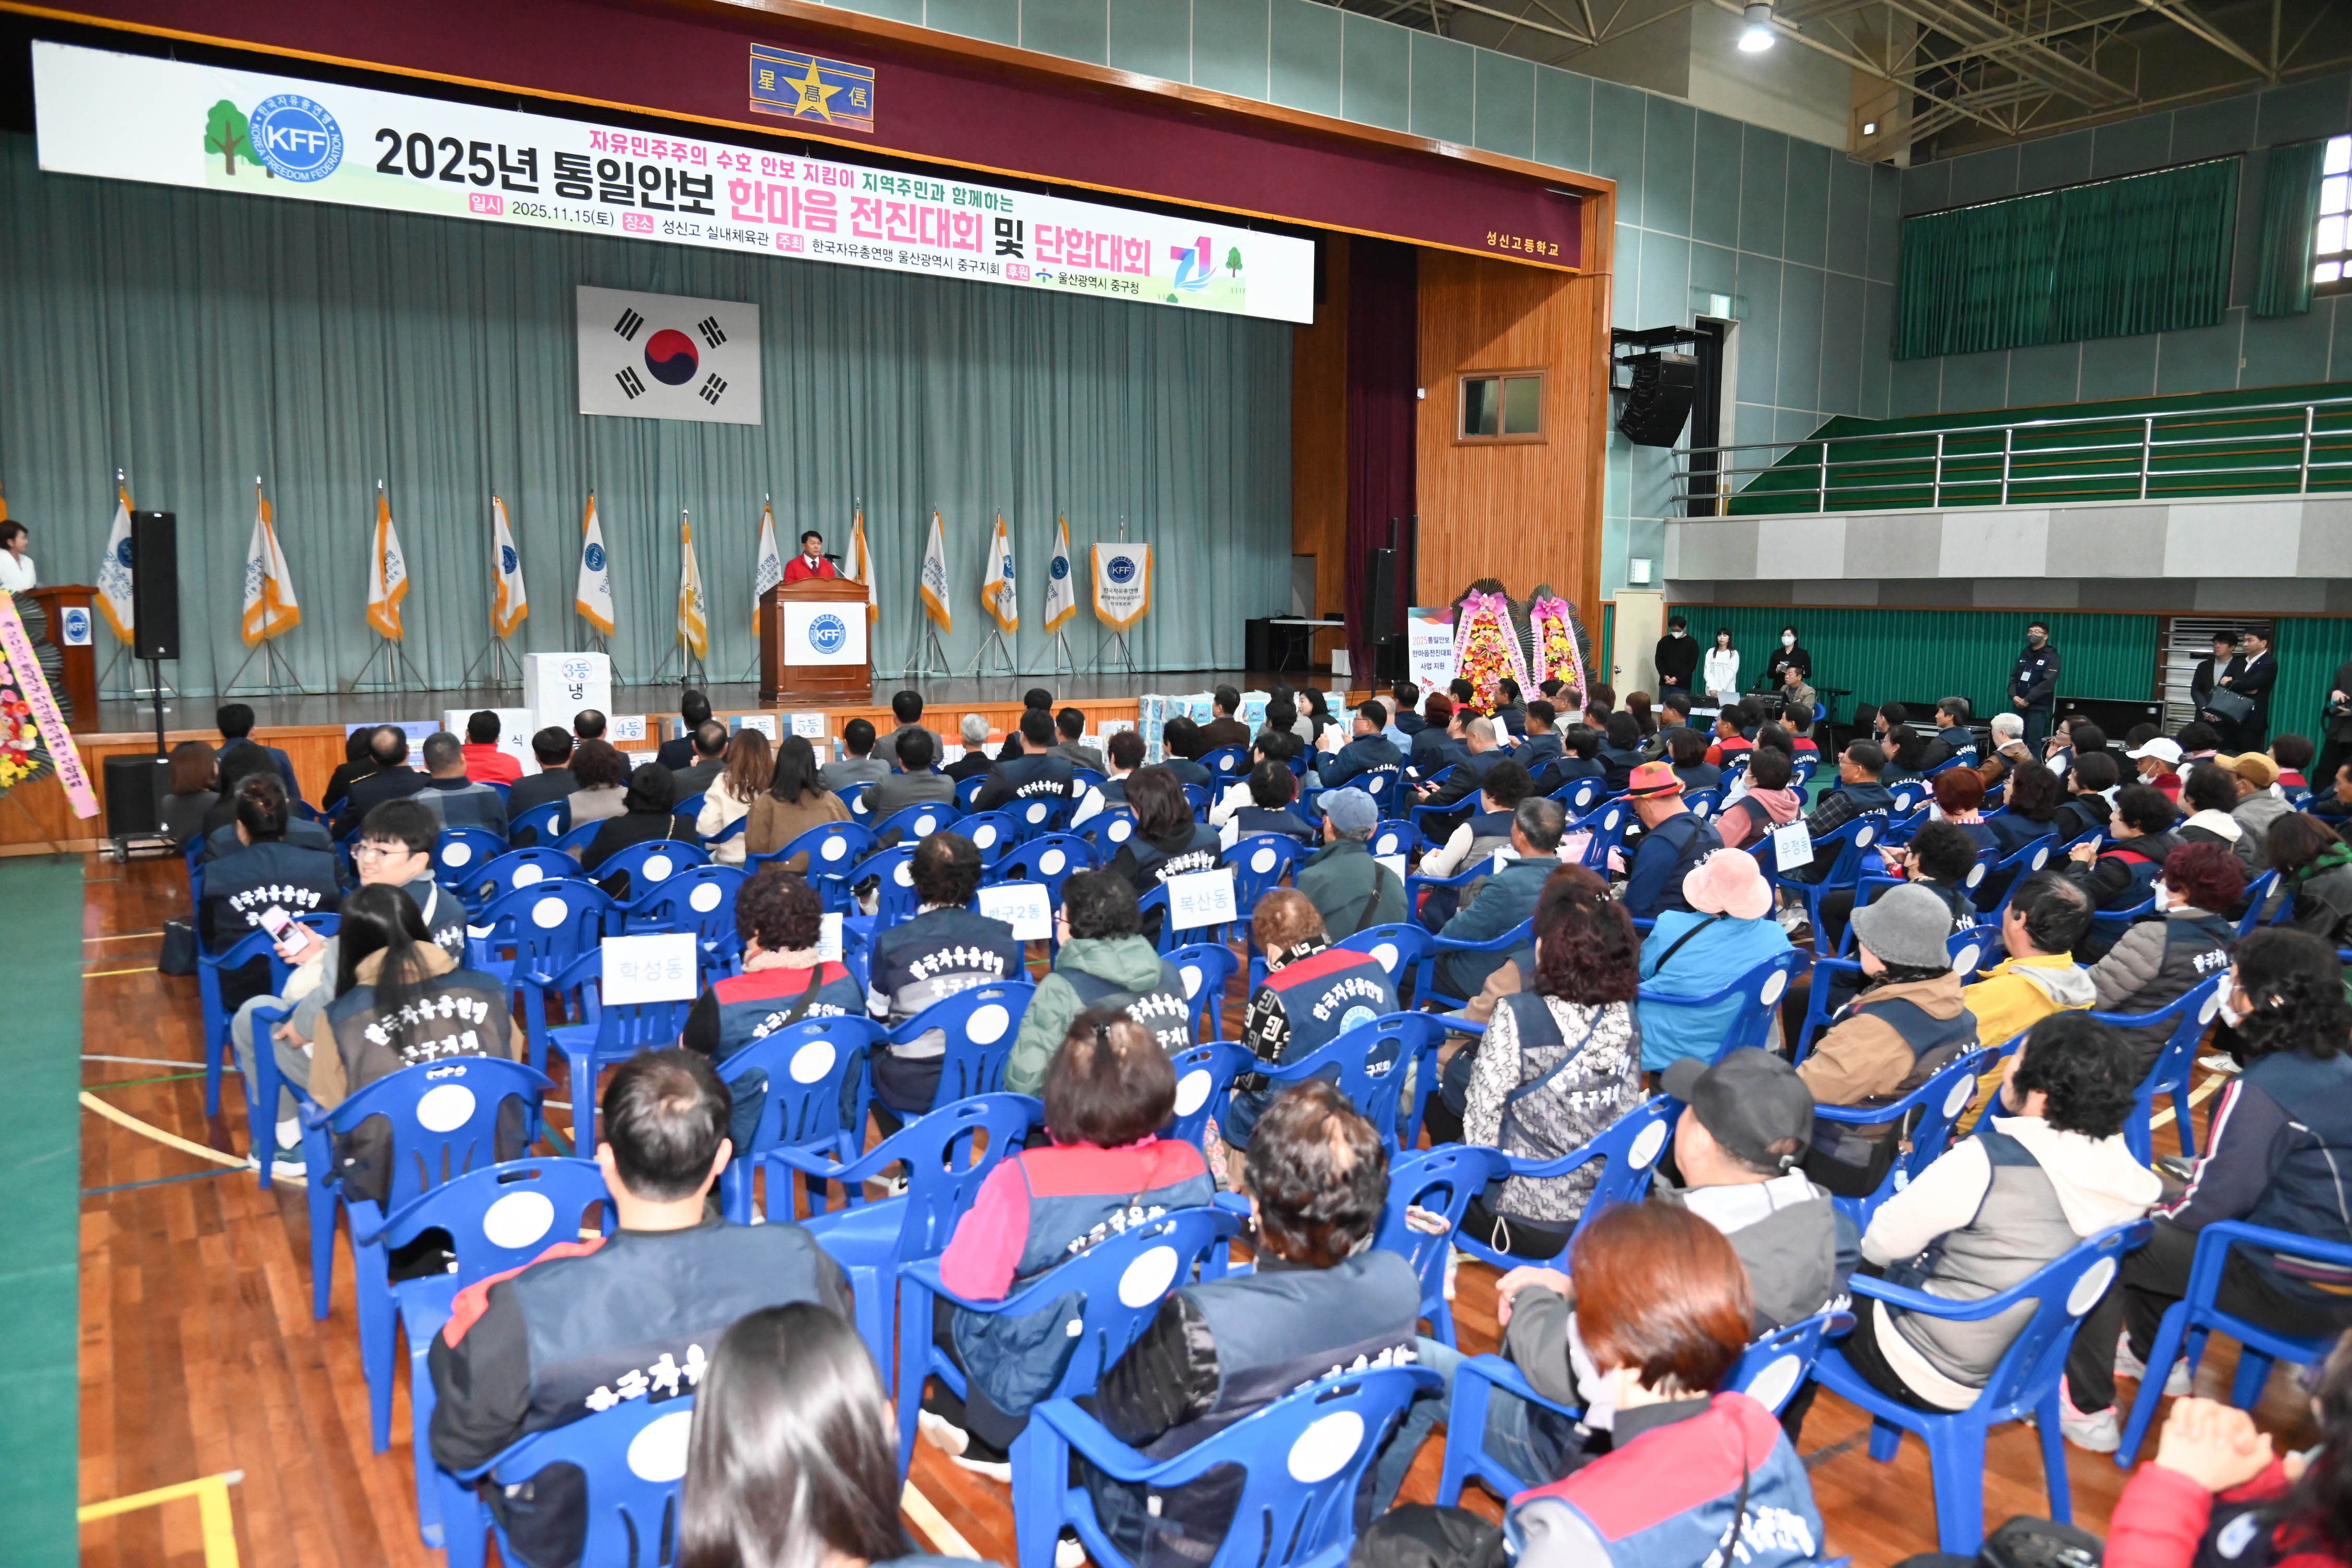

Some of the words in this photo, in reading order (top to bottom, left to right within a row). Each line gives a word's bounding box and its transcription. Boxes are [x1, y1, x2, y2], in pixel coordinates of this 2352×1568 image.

[758, 69, 776, 91] 星
[848, 87, 867, 108] 信
[251, 123, 266, 156] KOREA
[263, 156, 310, 180] FREEDOM
[310, 134, 342, 179] FEDERATION
[267, 125, 326, 154] KFF
[590, 130, 707, 166] 자유민주주의
[717, 150, 752, 173] 수호
[761, 156, 794, 179] 안보
[803, 163, 854, 188] 지킴이
[862, 172, 945, 202] 지역주민과
[952, 187, 1013, 213] 함께하는
[375, 128, 539, 194] 2025년
[554, 151, 715, 216] 통일안보
[728, 178, 838, 234] 한마음
[851, 196, 982, 253] 전진대회
[995, 217, 1024, 259] 및
[1035, 224, 1150, 277] 단합대회
[472, 195, 501, 214] 일시
[512, 201, 614, 227] 2025.11.15(토)
[624, 215, 653, 231] 장소
[662, 219, 701, 237] 성신고
[707, 225, 769, 246] 실내체육관
[778, 234, 803, 251] 주최
[812, 239, 893, 262] 한국자유총연맹
[898, 250, 953, 270] 울산광역시
[958, 258, 999, 276] 중구지회
[1007, 264, 1029, 280] 후원
[1058, 271, 1107, 290] 울산광역시
[1111, 279, 1139, 295] 중구청
[1487, 231, 1559, 256] 성신고등학교
[816, 629, 840, 641] KFF
[1413, 636, 1450, 645] 2025통일안보
[565, 663, 590, 678] 3등
[569, 683, 583, 699] 냉
[618, 721, 641, 737] 4등
[799, 719, 819, 733] 5등
[1016, 780, 1063, 798] 한국자유총연맹
[1781, 837, 1808, 858] 우정동
[229, 884, 321, 912] 한국자유총연맹
[1180, 889, 1228, 913] 복산동
[620, 958, 684, 983] 학성동
[909, 946, 1004, 980] 한국자유총연맹
[1313, 977, 1383, 1021] 한국자유총연맹
